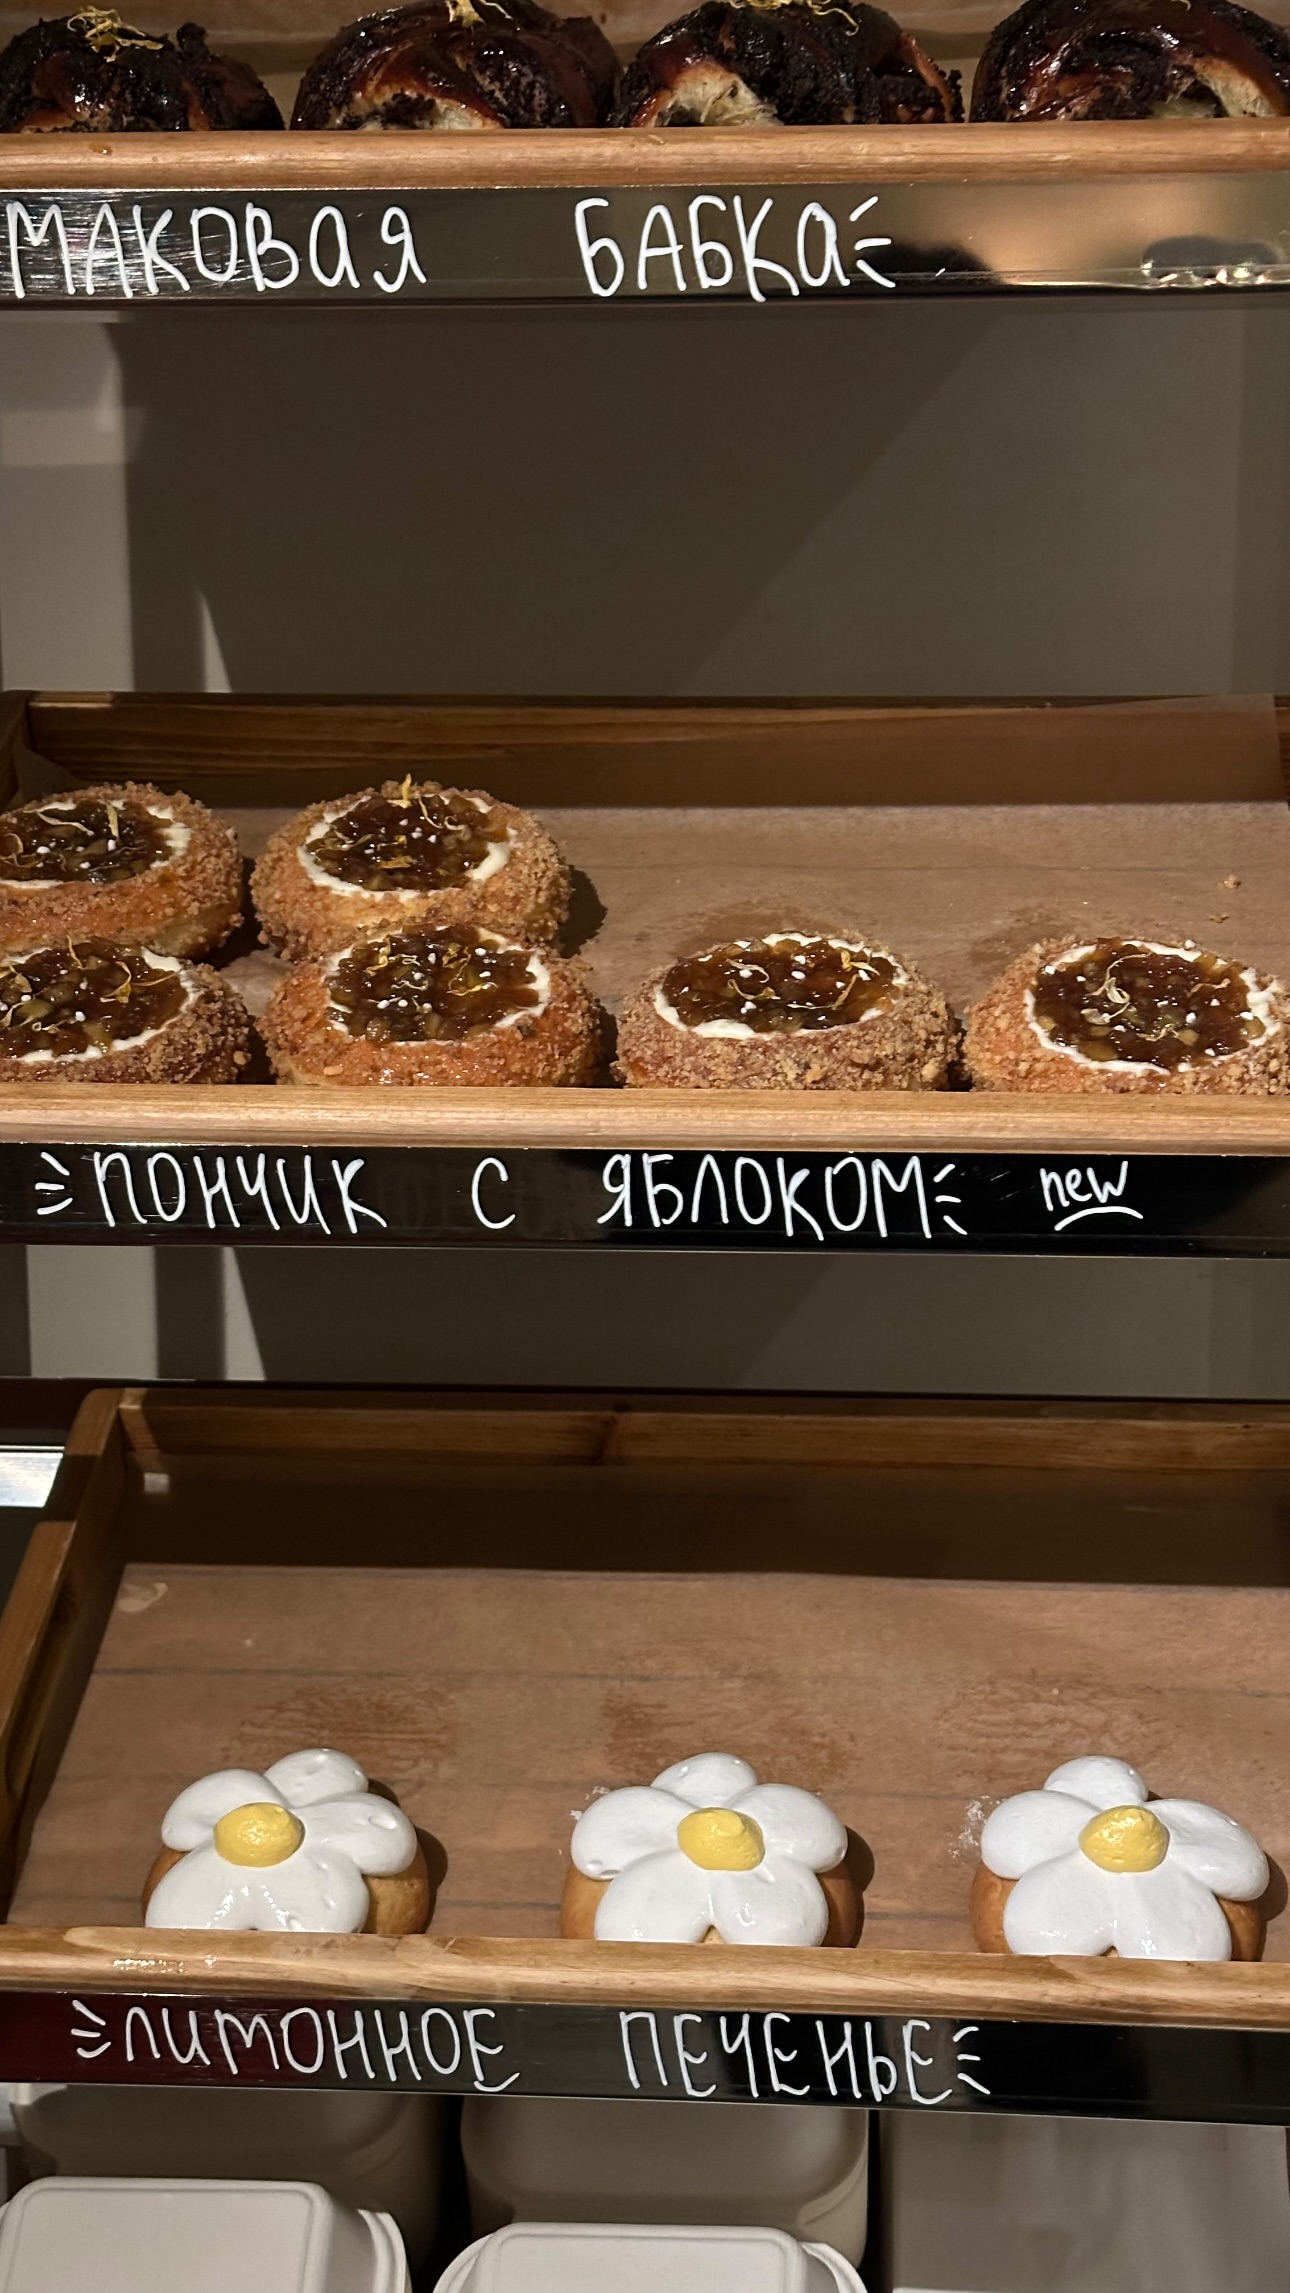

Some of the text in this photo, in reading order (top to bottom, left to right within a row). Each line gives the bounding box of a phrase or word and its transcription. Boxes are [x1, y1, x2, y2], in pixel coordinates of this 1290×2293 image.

[93, 1151, 388, 1234] ПОНЧИК
[597, 1153, 932, 1241] ЯБЛОКОМ
[1040, 1161, 1129, 1211] new
[125, 2006, 952, 2104] ЛИМОННОЕ ПЕЧЕНЬЕ
